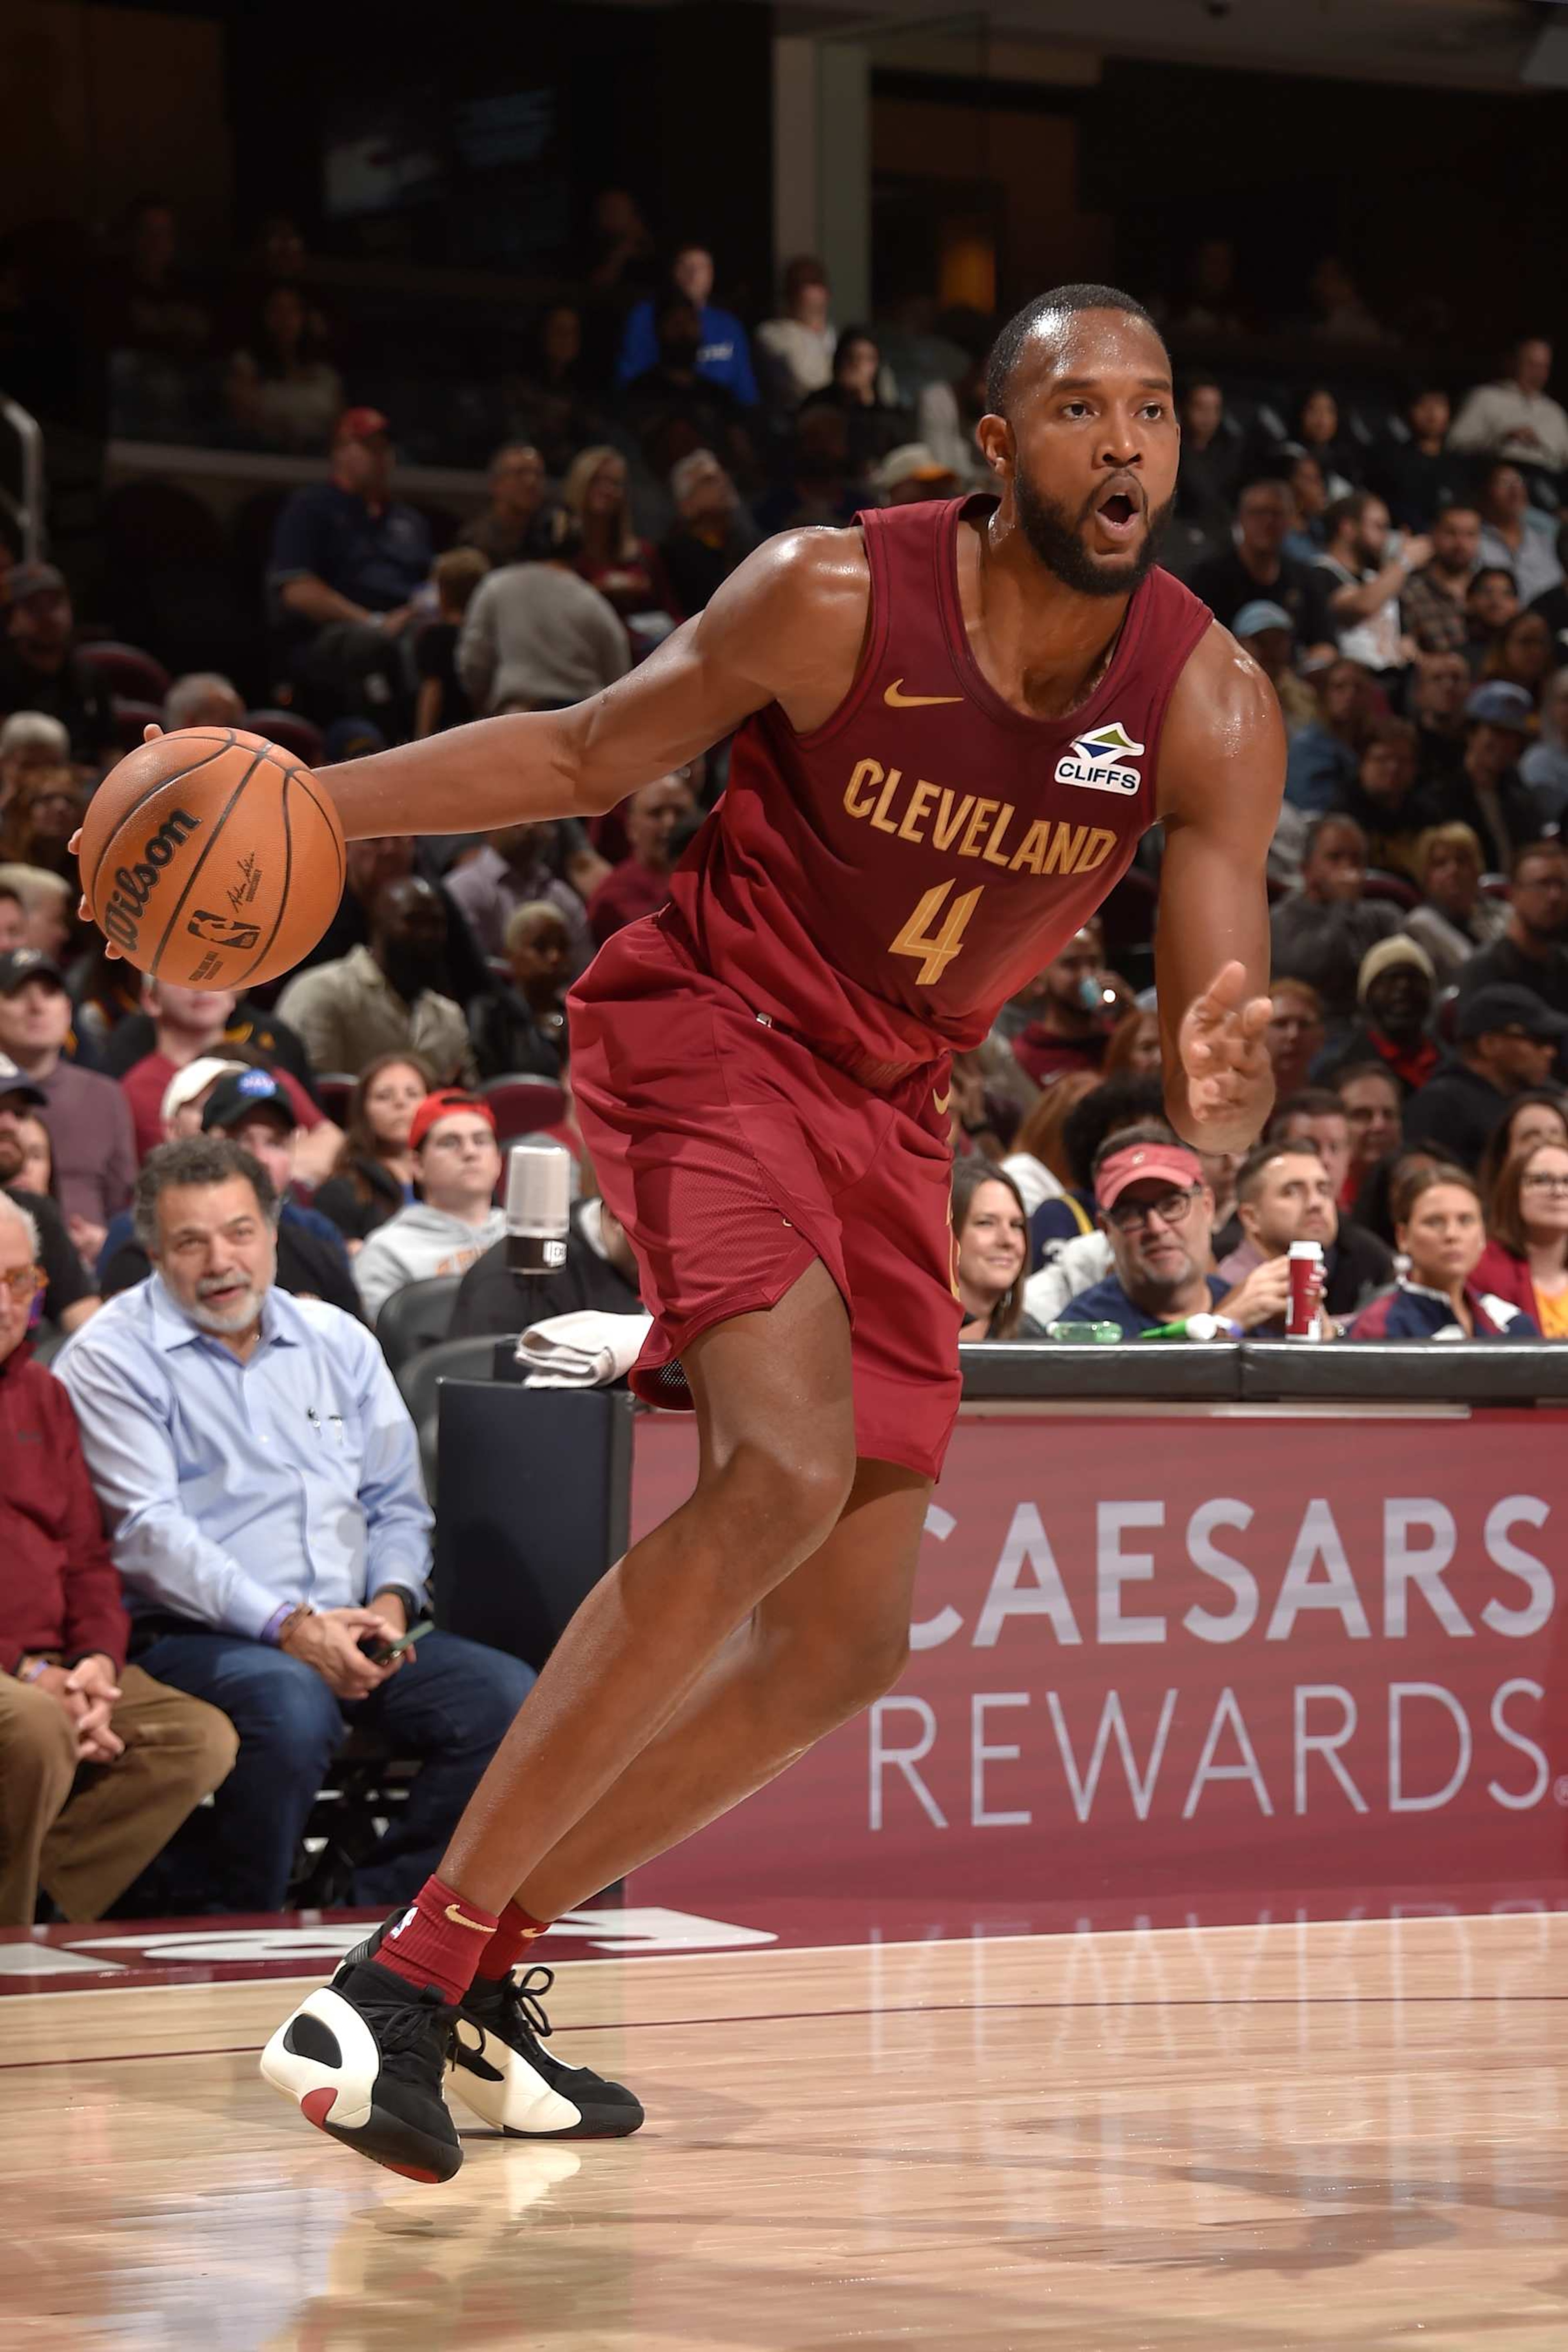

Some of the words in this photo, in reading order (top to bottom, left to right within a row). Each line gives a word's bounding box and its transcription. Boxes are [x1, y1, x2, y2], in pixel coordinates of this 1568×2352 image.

[843, 758, 1117, 875] CLEVELAND
[1058, 762, 1136, 790] CLIFFS
[105, 808, 203, 951] Wilson
[888, 878, 985, 985] 4
[869, 1677, 1550, 1830] REWARDS
